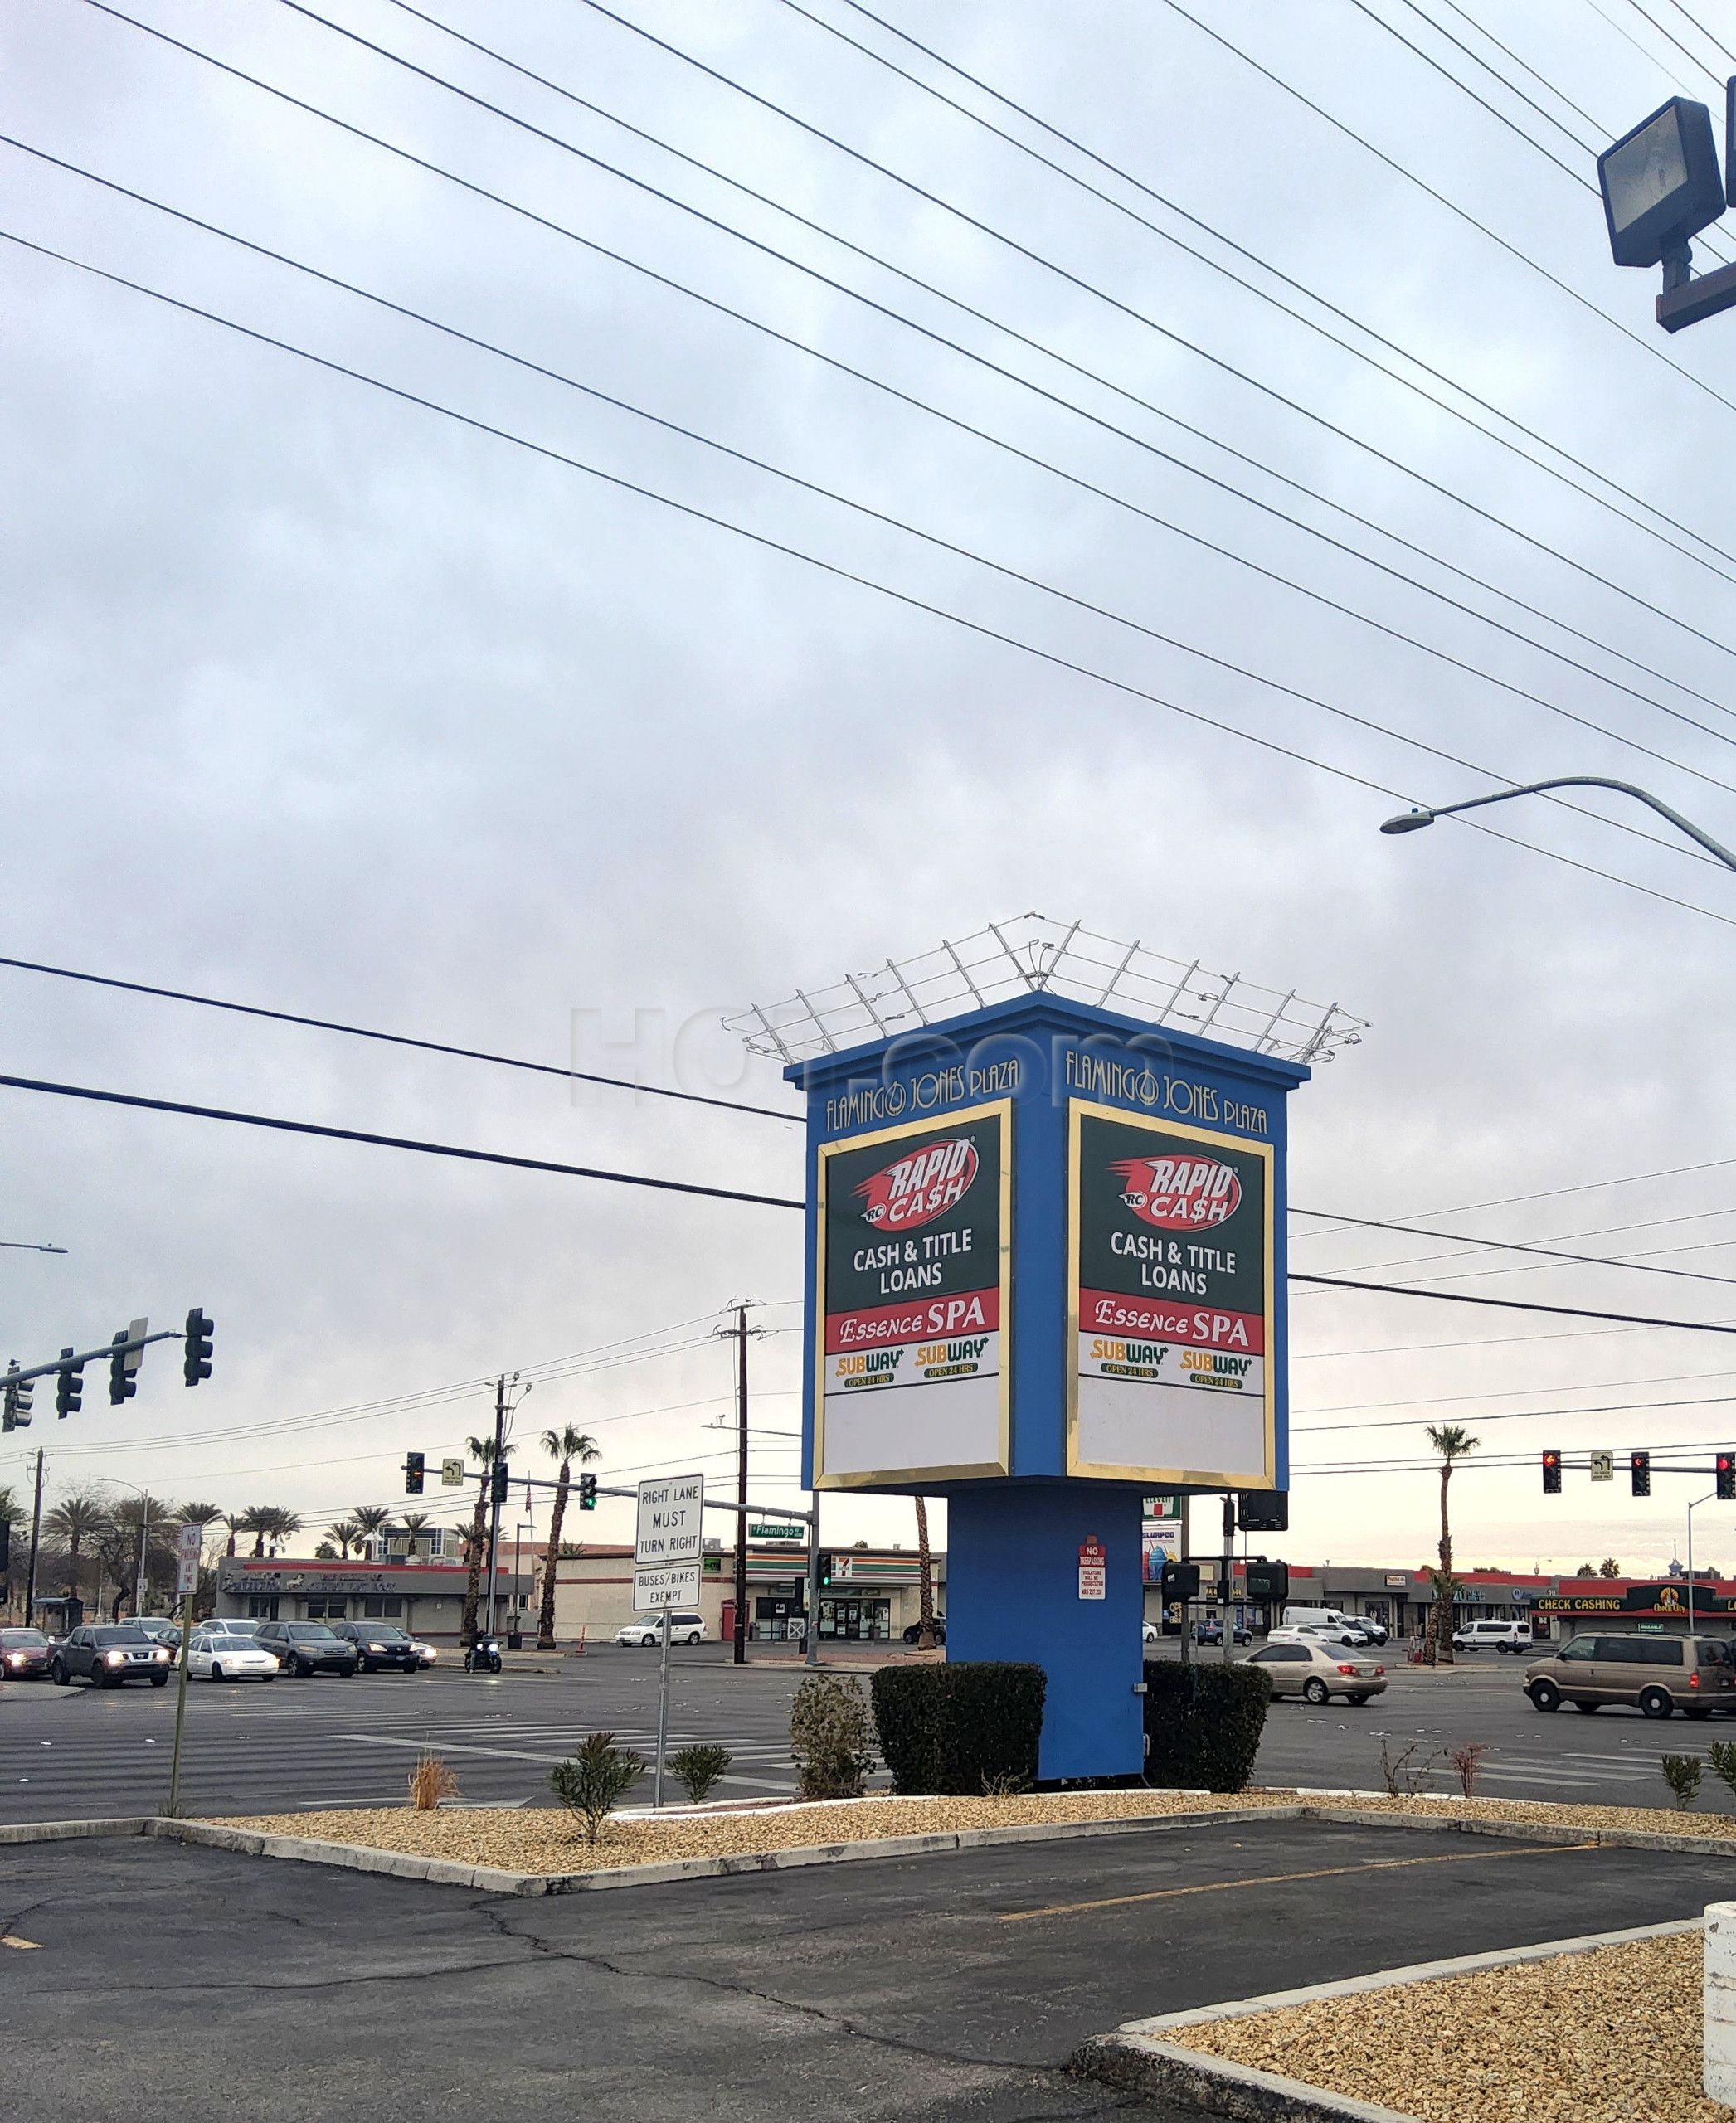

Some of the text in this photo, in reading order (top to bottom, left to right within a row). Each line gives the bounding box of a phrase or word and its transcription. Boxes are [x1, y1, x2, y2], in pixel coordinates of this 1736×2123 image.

[826, 1059, 1019, 1132] FLAMINGO JONES PLAZA
[1066, 1051, 1267, 1134] FLAMINGO JONES PLAZA
[884, 1139, 970, 1200] RAPID
[1144, 1159, 1233, 1198] RAPID
[1126, 1194, 1144, 1205] RC
[867, 1207, 883, 1221] RC
[853, 1228, 972, 1272] CASH & TITLE
[1111, 1231, 1236, 1274] CASH & TITLE
[880, 1262, 942, 1294] LOANS
[1141, 1263, 1207, 1295] LOANS
[926, 1296, 985, 1334] SPA
[1192, 1311, 1249, 1347] SPA
[835, 1348, 905, 1377] SUBWAY
[915, 1337, 989, 1367] SUBWAY
[1090, 1338, 1169, 1365] SUBWAY
[929, 1368, 948, 1377] OPEN
[958, 1363, 974, 1374] HRS
[1106, 1365, 1154, 1377] OPEN 24 HRS
[1180, 1351, 1252, 1377] SUBWAY
[849, 1377, 868, 1387] OPEN
[876, 1374, 890, 1383] HRS
[1194, 1375, 1214, 1386] OPEN
[1224, 1378, 1238, 1387] HRS
[642, 1485, 699, 1504] RIGHT LANE
[653, 1510, 686, 1529] MUST
[187, 1533, 196, 1545] NO
[756, 1525, 794, 1538] Flamingo
[639, 1535, 698, 1554] TURN RIGHT
[1086, 1547, 1099, 1556] NO
[649, 1589, 682, 1604] EXEMPT
[1538, 1599, 1620, 1610] CHECK CASHING
